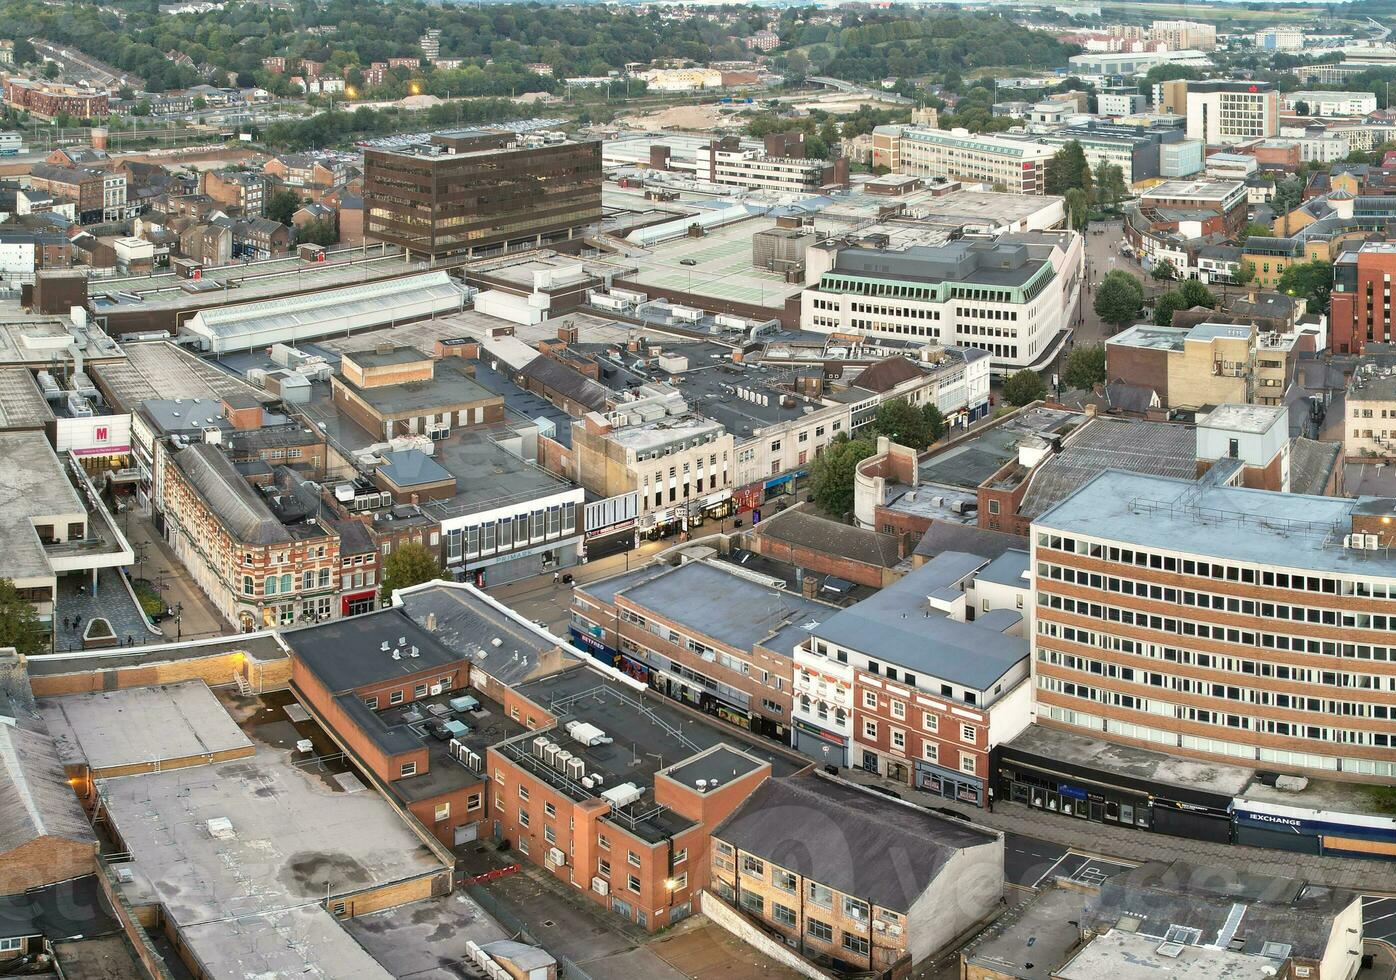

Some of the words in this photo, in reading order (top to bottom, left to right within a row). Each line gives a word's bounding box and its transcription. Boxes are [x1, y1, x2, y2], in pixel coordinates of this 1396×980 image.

[96, 427, 107, 440] M
[496, 550, 533, 563] PRIMARK
[581, 634, 605, 650] BETFRED
[1253, 814, 1301, 827] EXCHANGE
